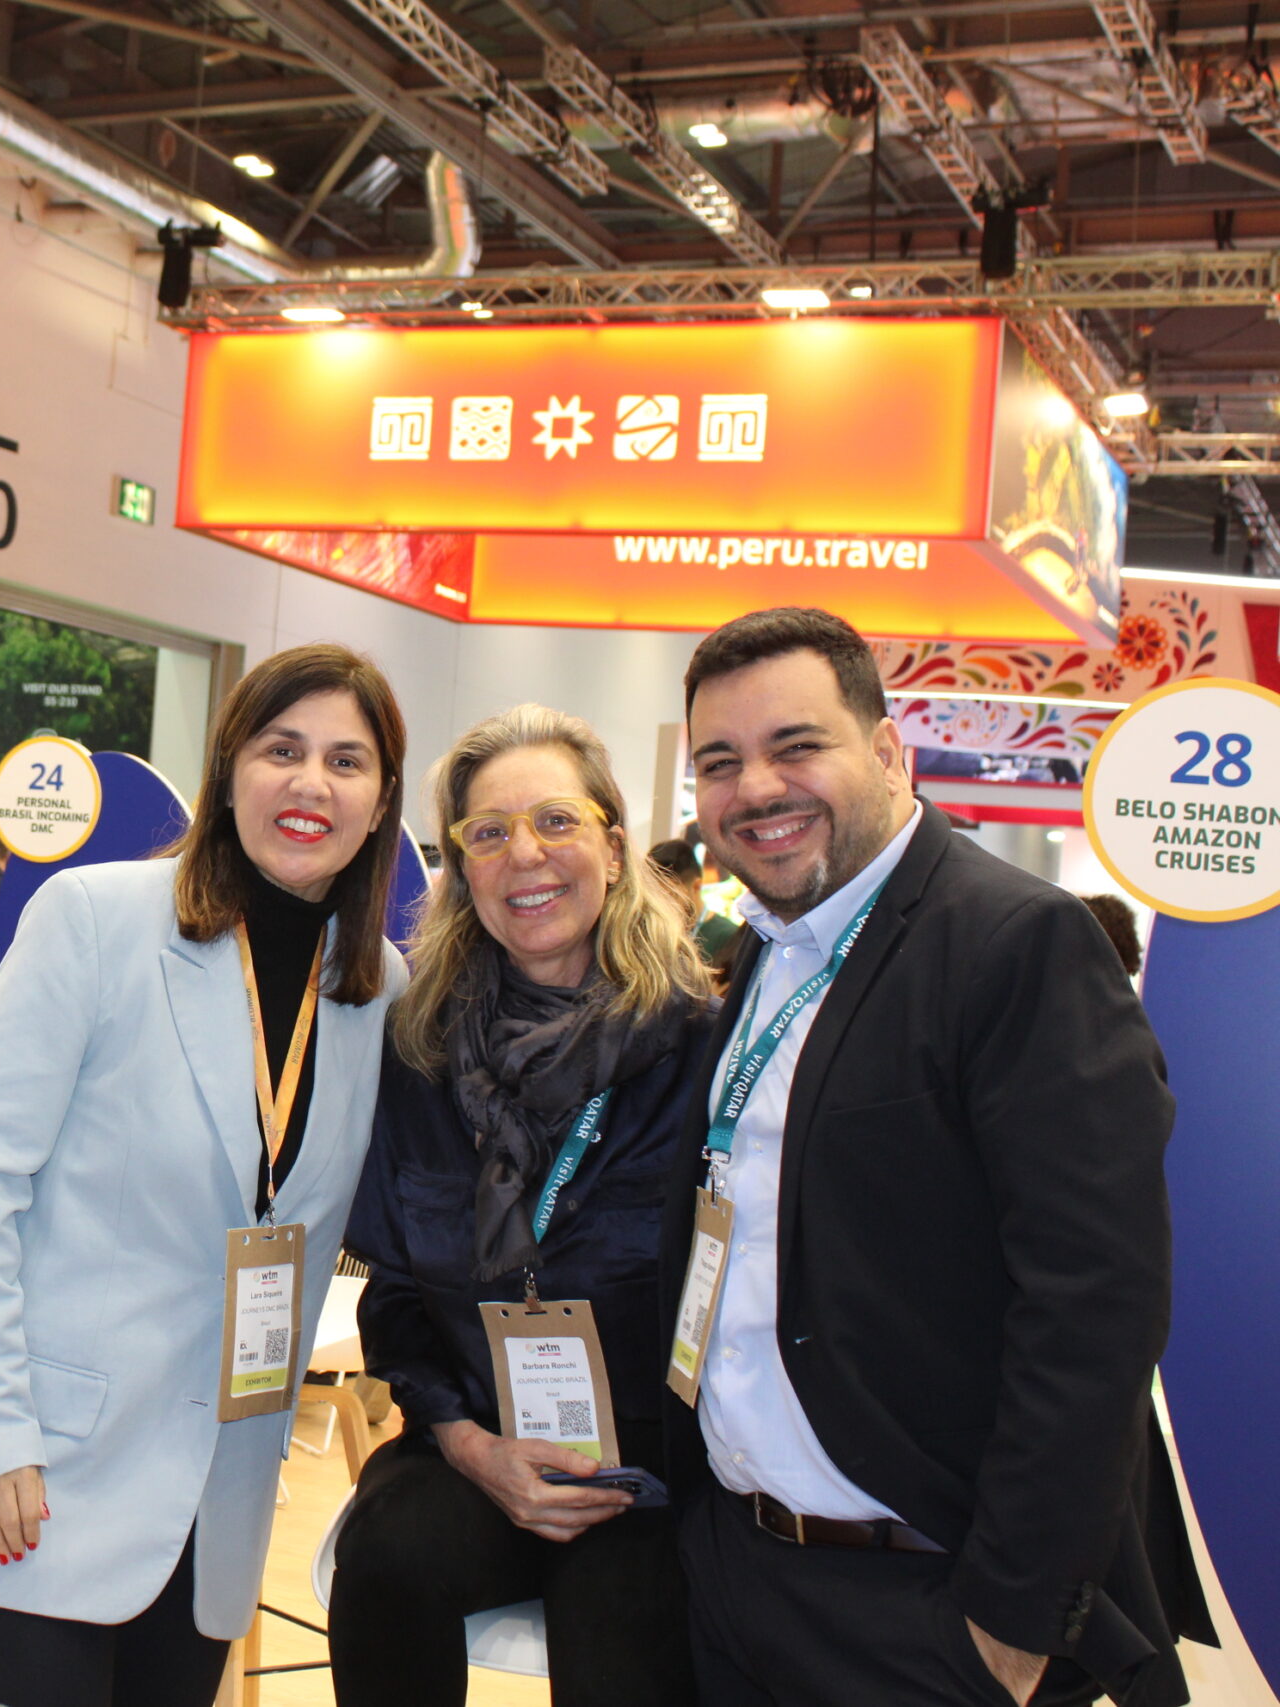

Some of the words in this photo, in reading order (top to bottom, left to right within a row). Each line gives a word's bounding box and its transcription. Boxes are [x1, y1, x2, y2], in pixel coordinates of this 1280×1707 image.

[614, 536, 928, 570] www.peru.travel
[22, 682, 46, 695] VISIT
[47, 683, 69, 695] OUR
[70, 684, 103, 697] STAND
[1170, 731, 1252, 787] 28
[29, 763, 64, 791] 24
[16, 796, 71, 809] PERSONAL
[37, 811, 90, 823] INCOMING
[1115, 798, 1176, 820] BELO
[1183, 802, 1280, 826] SHABON
[30, 823, 54, 834] DMC
[1152, 825, 1261, 850] AMAZON
[1155, 850, 1256, 875] CRUISES
[261, 1270, 278, 1280] wtm
[536, 1342, 560, 1352] wtm
[522, 1362, 550, 1370] Barbara
